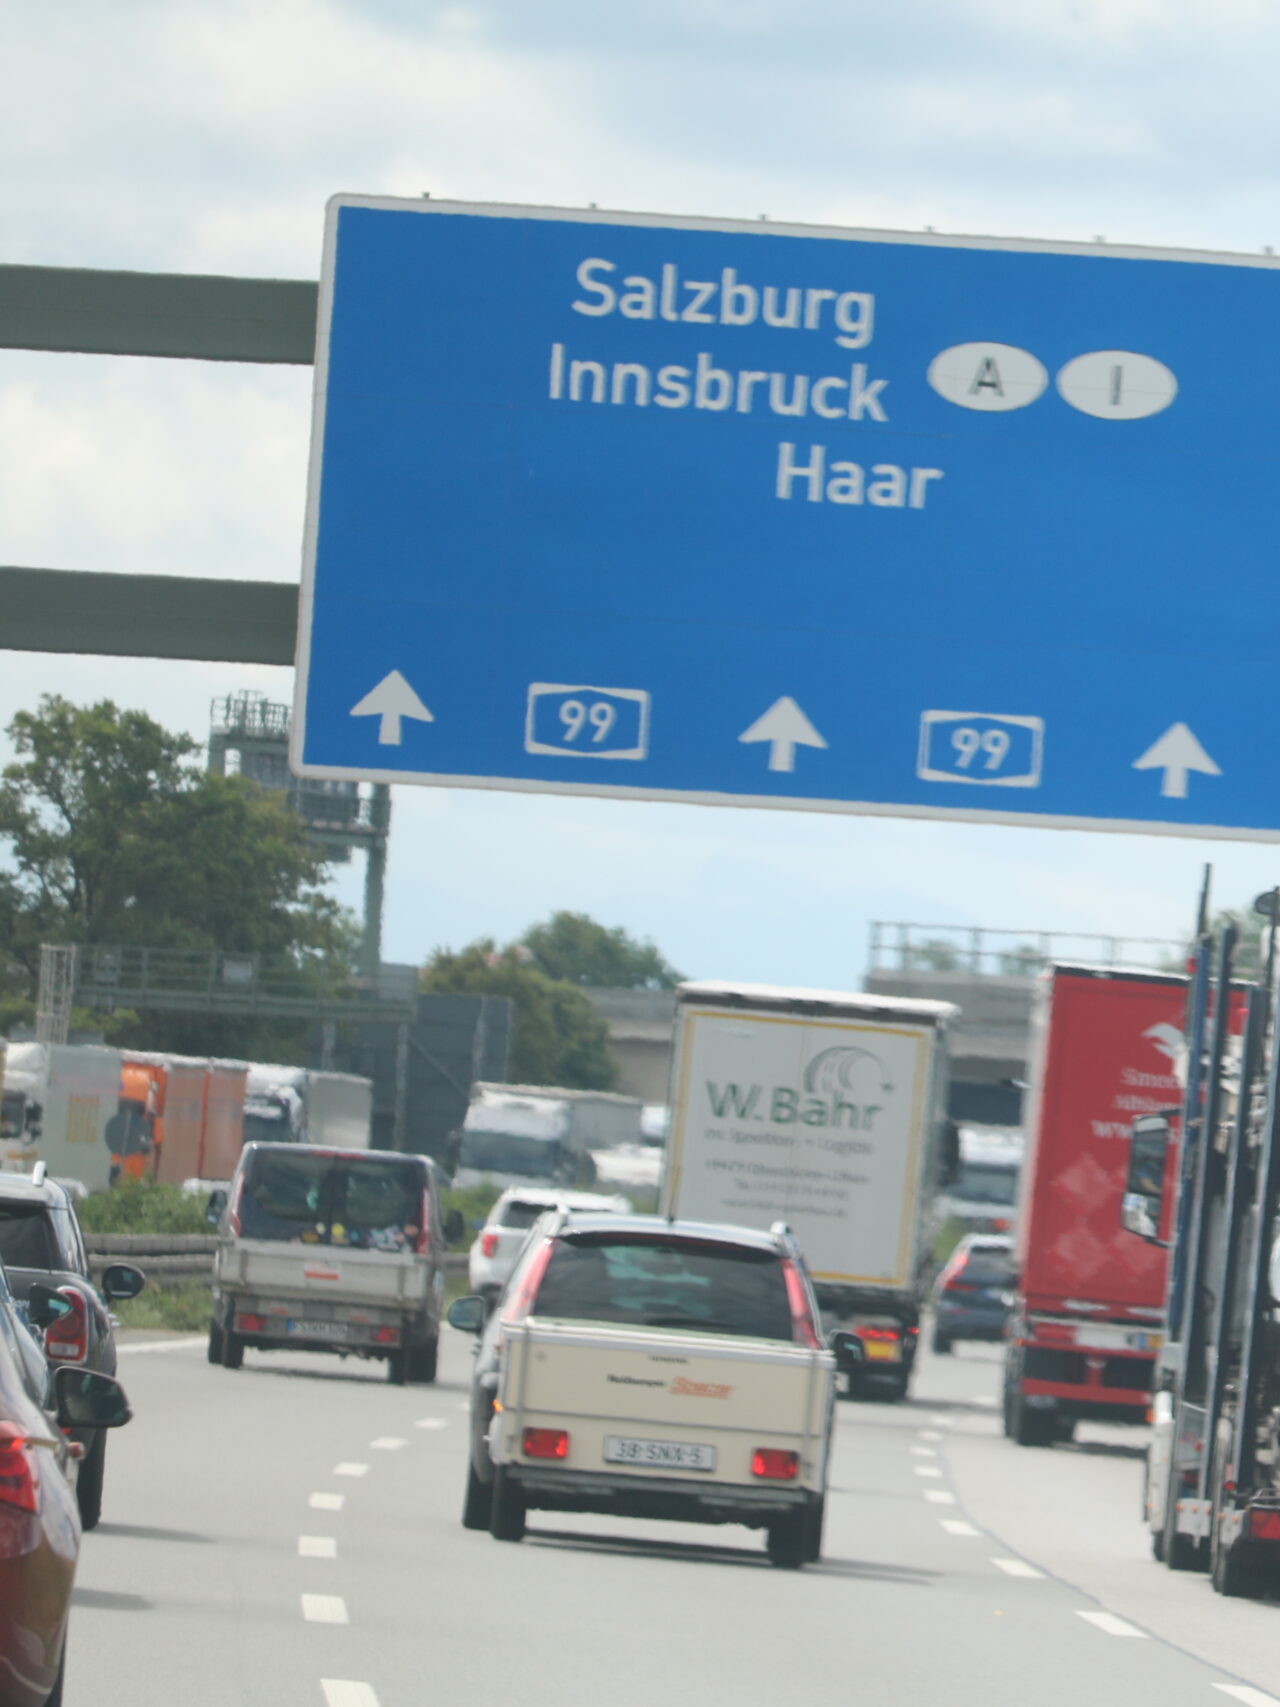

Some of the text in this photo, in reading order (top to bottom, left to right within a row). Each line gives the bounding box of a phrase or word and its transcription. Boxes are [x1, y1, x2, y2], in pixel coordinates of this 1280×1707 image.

[571, 257, 876, 348] Salzburg
[548, 342, 890, 423] Innsbruck
[966, 356, 1006, 398] A
[1110, 363, 1124, 407] I
[775, 442, 946, 510] Haar
[558, 700, 617, 743] 99
[950, 728, 1010, 772] 99
[705, 1080, 884, 1133] W.Bahr
